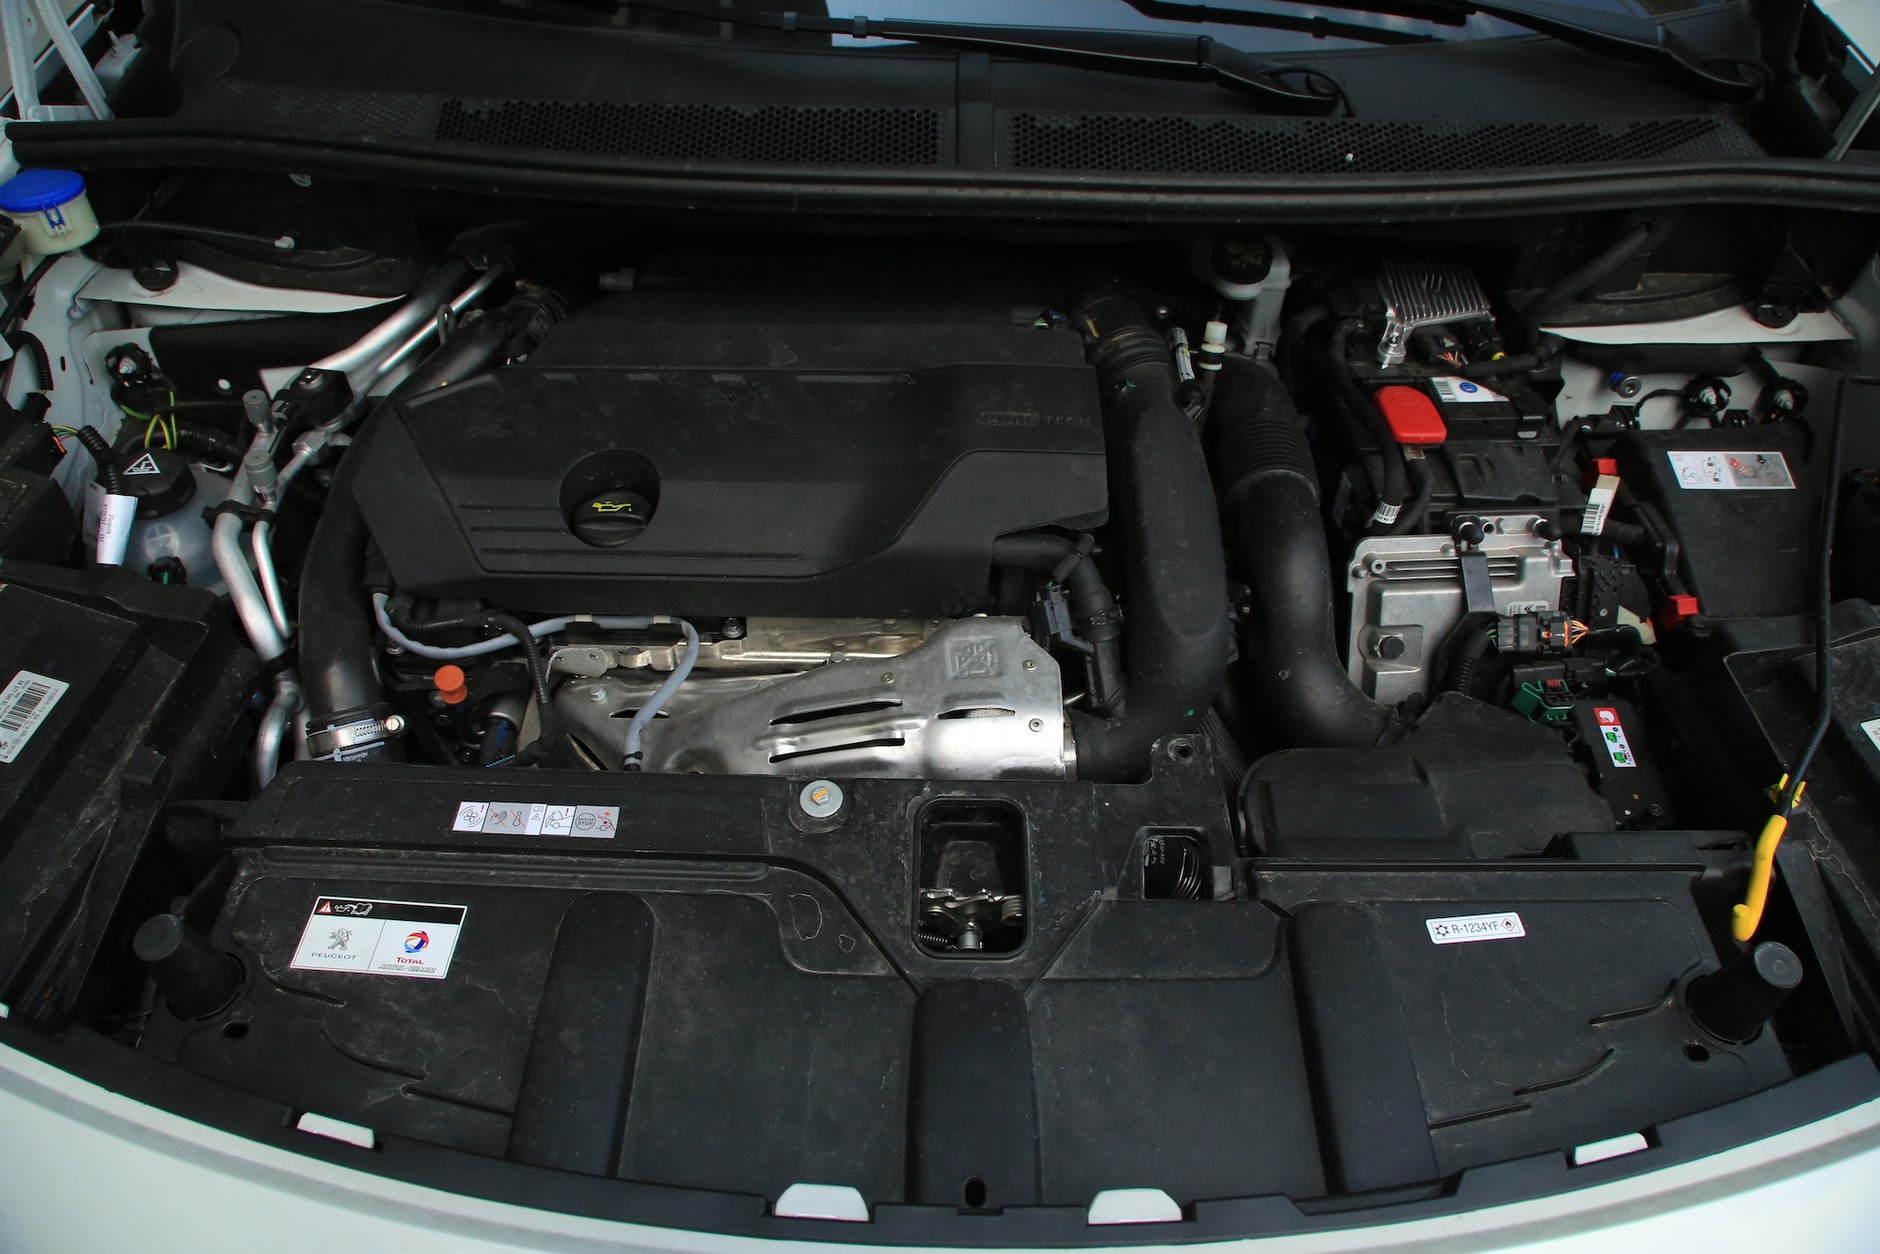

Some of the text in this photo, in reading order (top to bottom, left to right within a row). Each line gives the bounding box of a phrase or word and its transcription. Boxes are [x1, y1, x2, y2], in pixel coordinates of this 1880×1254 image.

[1451, 921, 1499, 934] R-1234YF
[311, 952, 357, 960] PEUGEOT
[396, 956, 424, 965] TOTAL
